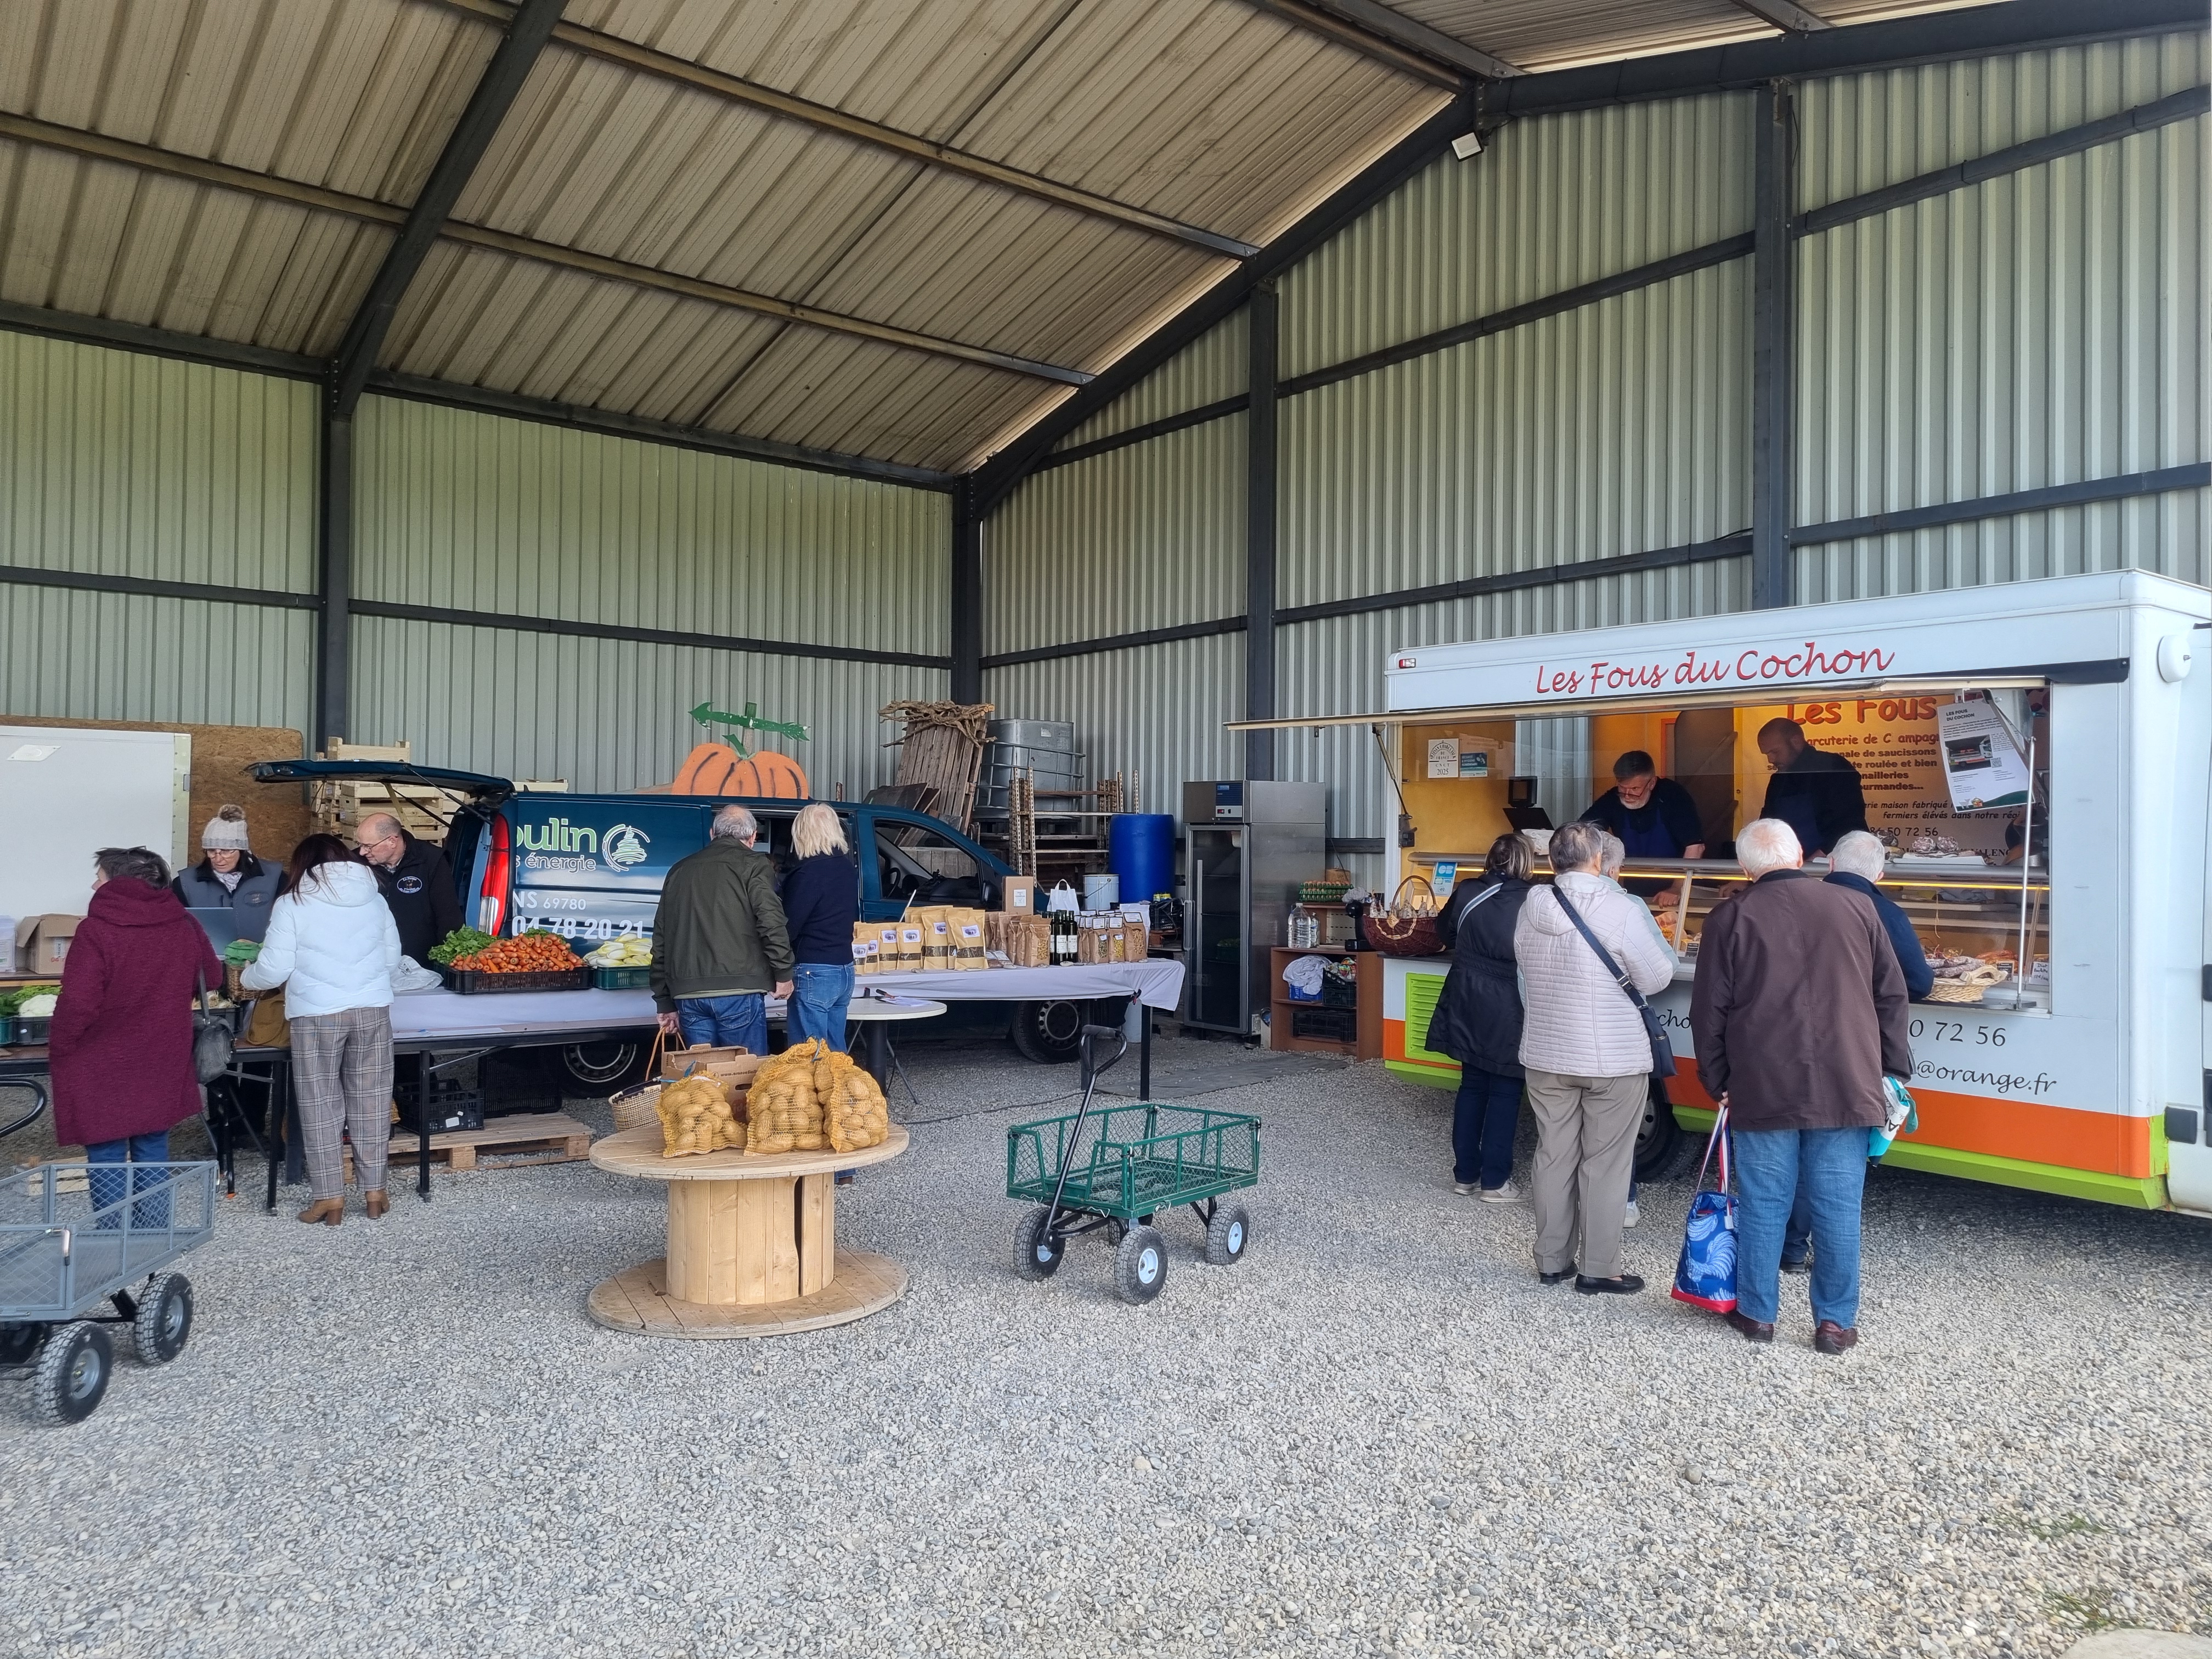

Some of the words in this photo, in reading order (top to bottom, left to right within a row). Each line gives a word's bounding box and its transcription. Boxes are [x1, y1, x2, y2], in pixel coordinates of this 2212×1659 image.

[1536, 665, 1584, 695] Les
[1590, 662, 1669, 695] Fous
[1674, 651, 1731, 684] du
[1736, 642, 1895, 680] Cochon
[1787, 702, 1842, 726] Les
[1857, 697, 1937, 724] Fous
[1807, 735, 1858, 747] arcuterie
[1863, 733, 1878, 744] de
[1883, 733, 1892, 743] C
[1839, 750, 1860, 758] nale
[1878, 748, 1937, 757] saucissons
[1865, 760, 1898, 768] roulée
[1915, 759, 1937, 767] bien
[1861, 771, 1909, 780] nailleries
[1863, 782, 1924, 791] urmandes...
[1912, 800, 1948, 810] fabriqué
[1922, 811, 1948, 819] élévés
[1905, 827, 1920, 837] 72
[1925, 827, 1939, 837] 56
[525, 853, 596, 873] énergie
[543, 898, 587, 911] 69780
[512, 915, 539, 936] 04
[549, 917, 577, 940] 78
[584, 918, 612, 940] 20
[619, 919, 644, 939] 21
[1657, 1009, 1691, 1029] cho
[1909, 1019, 1924, 1038] 0
[1935, 1022, 1964, 1043] 72
[1976, 1026, 2007, 1047] 56
[1917, 1060, 2057, 1096] @orange.fr
